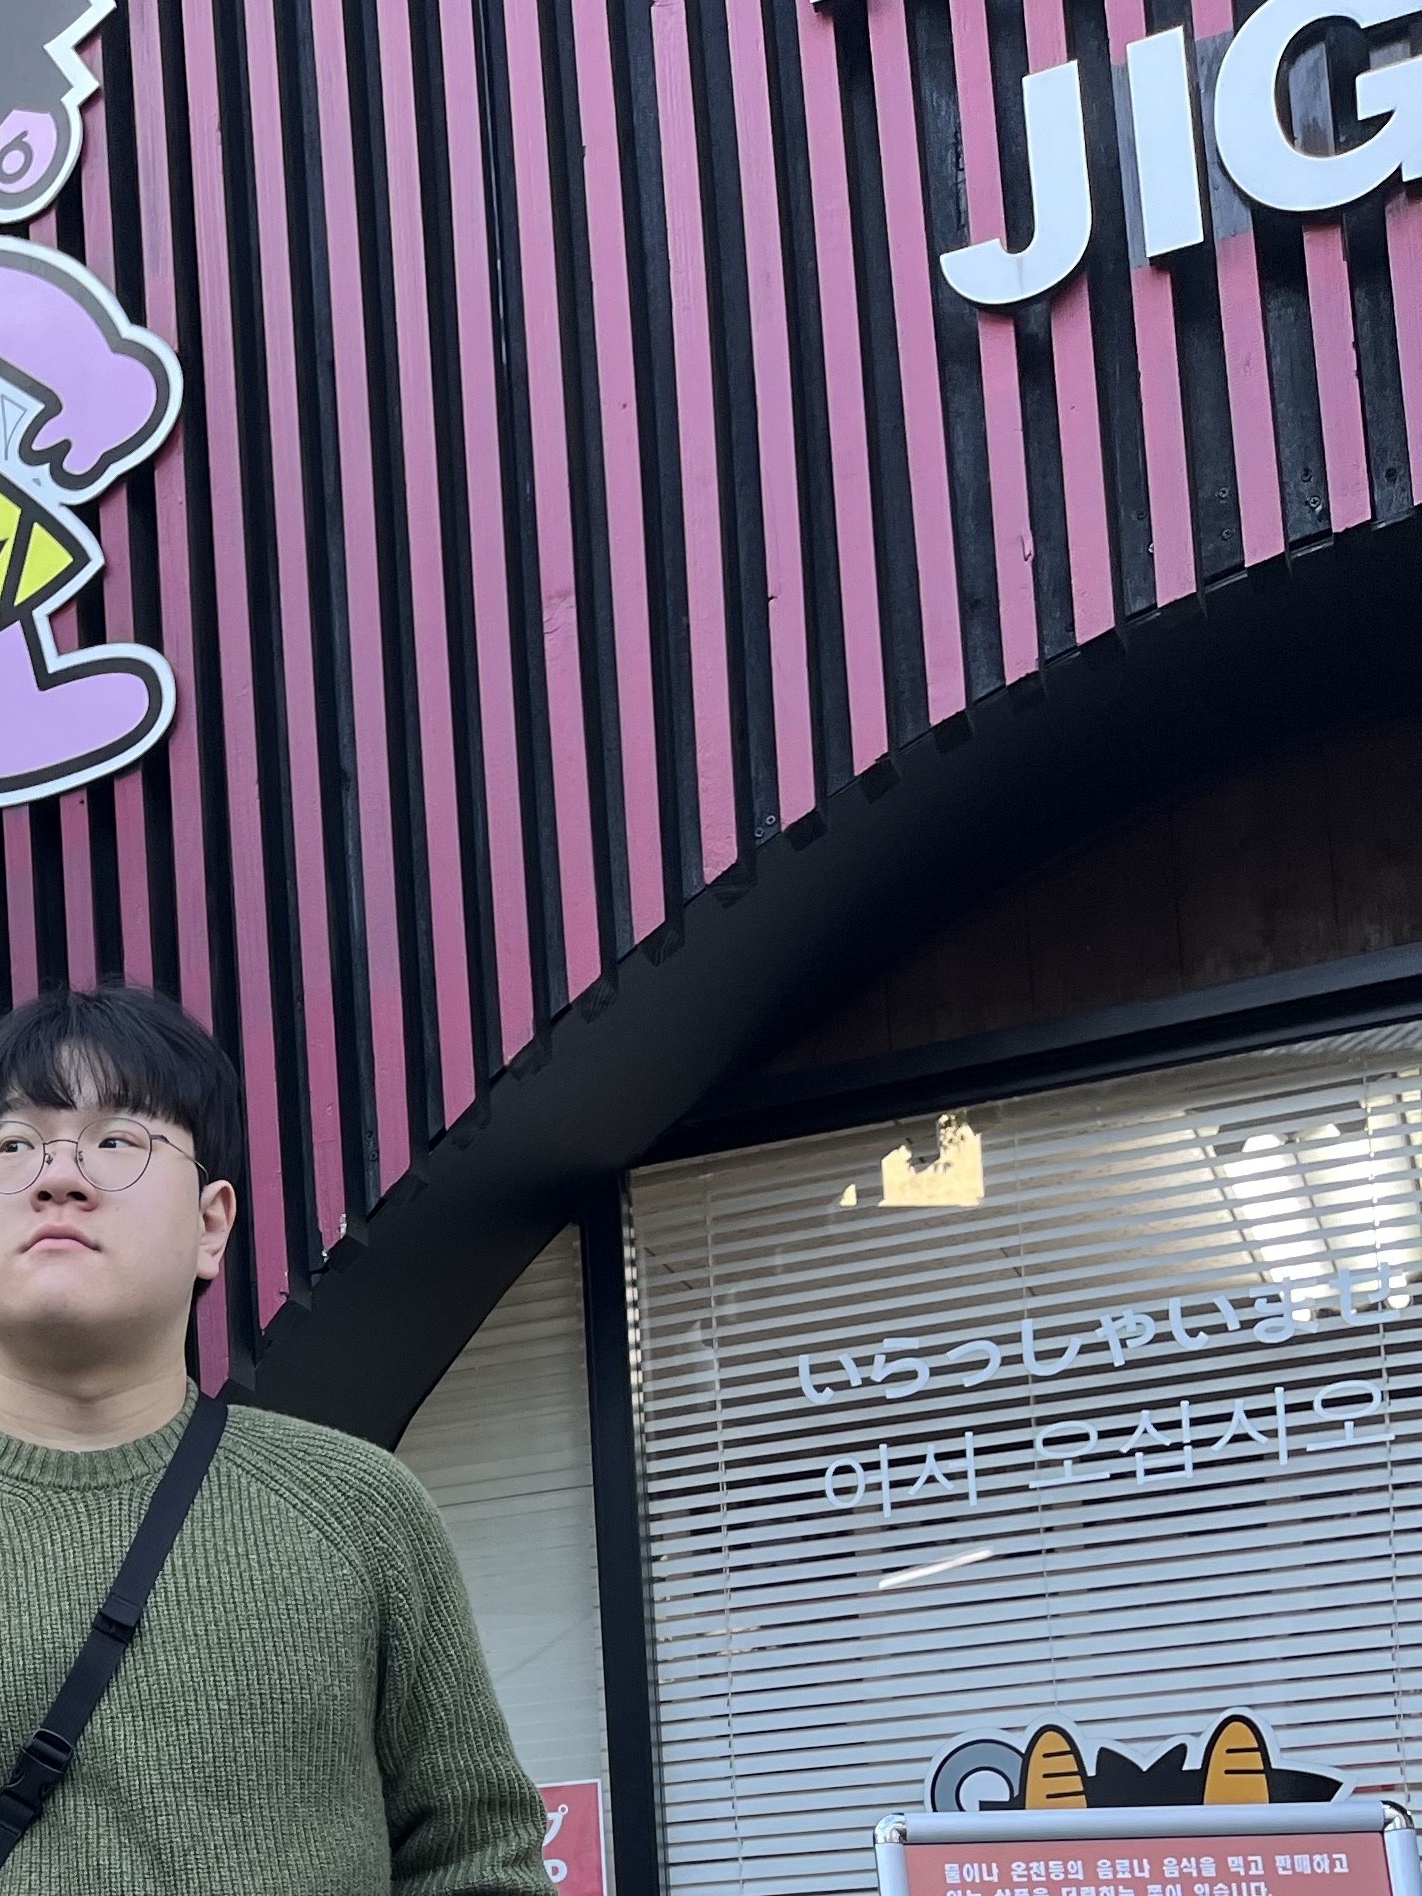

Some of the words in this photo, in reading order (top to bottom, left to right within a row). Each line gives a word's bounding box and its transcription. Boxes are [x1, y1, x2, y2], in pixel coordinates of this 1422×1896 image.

[939, 0, 1422, 306] JIG
[824, 1431, 978, 1518] 어서
[1028, 1379, 1397, 1490] 오십시오
[944, 1862, 999, 1884] 물이나
[1010, 1860, 1085, 1883] 온천등의
[1096, 1858, 1151, 1880] 음료나
[1162, 1857, 1217, 1878] 음식을
[1227, 1855, 1265, 1876] 먹고
[1274, 1853, 1349, 1876] 판매하고
